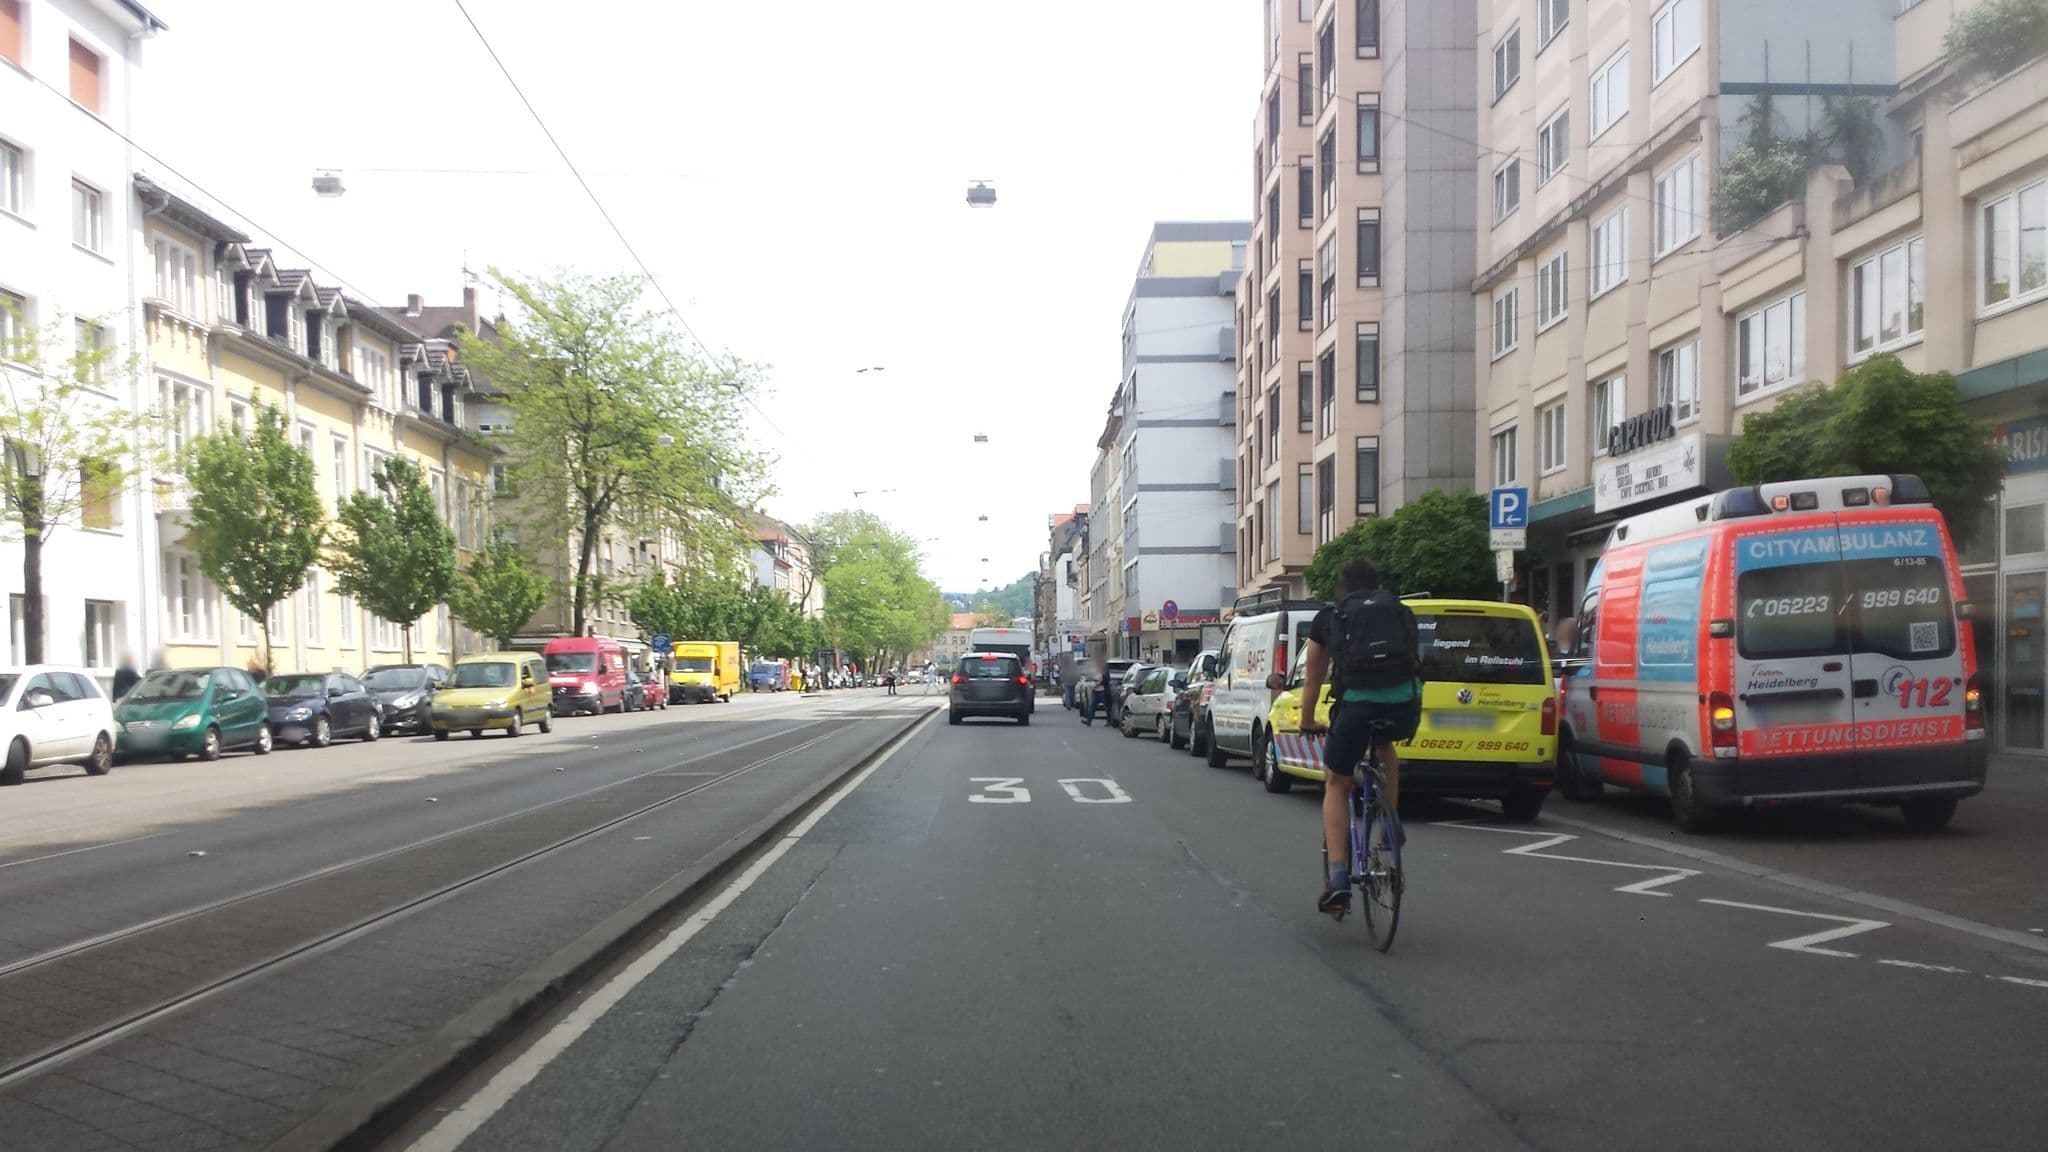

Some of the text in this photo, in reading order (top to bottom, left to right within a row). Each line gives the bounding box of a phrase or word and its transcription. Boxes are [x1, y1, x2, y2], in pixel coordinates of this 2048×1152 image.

[1608, 403, 1676, 457] CAPITOL
[1498, 492, 1519, 524] P
[1750, 529, 1928, 560] CITYAMBULANZ
[1764, 595, 1830, 617] 06223
[1863, 589, 1902, 609] 999
[1904, 587, 1940, 606] 640
[1433, 639, 1471, 649] liegend
[1464, 655, 1524, 666] im Rollstuhl
[1747, 676, 1819, 691] Heidelberg
[1899, 678, 1953, 708] 112
[1478, 698, 1526, 709] Heidelberg
[1420, 739, 1463, 750] 06223
[1477, 741, 1501, 751] 999
[1505, 742, 1529, 751] 640
